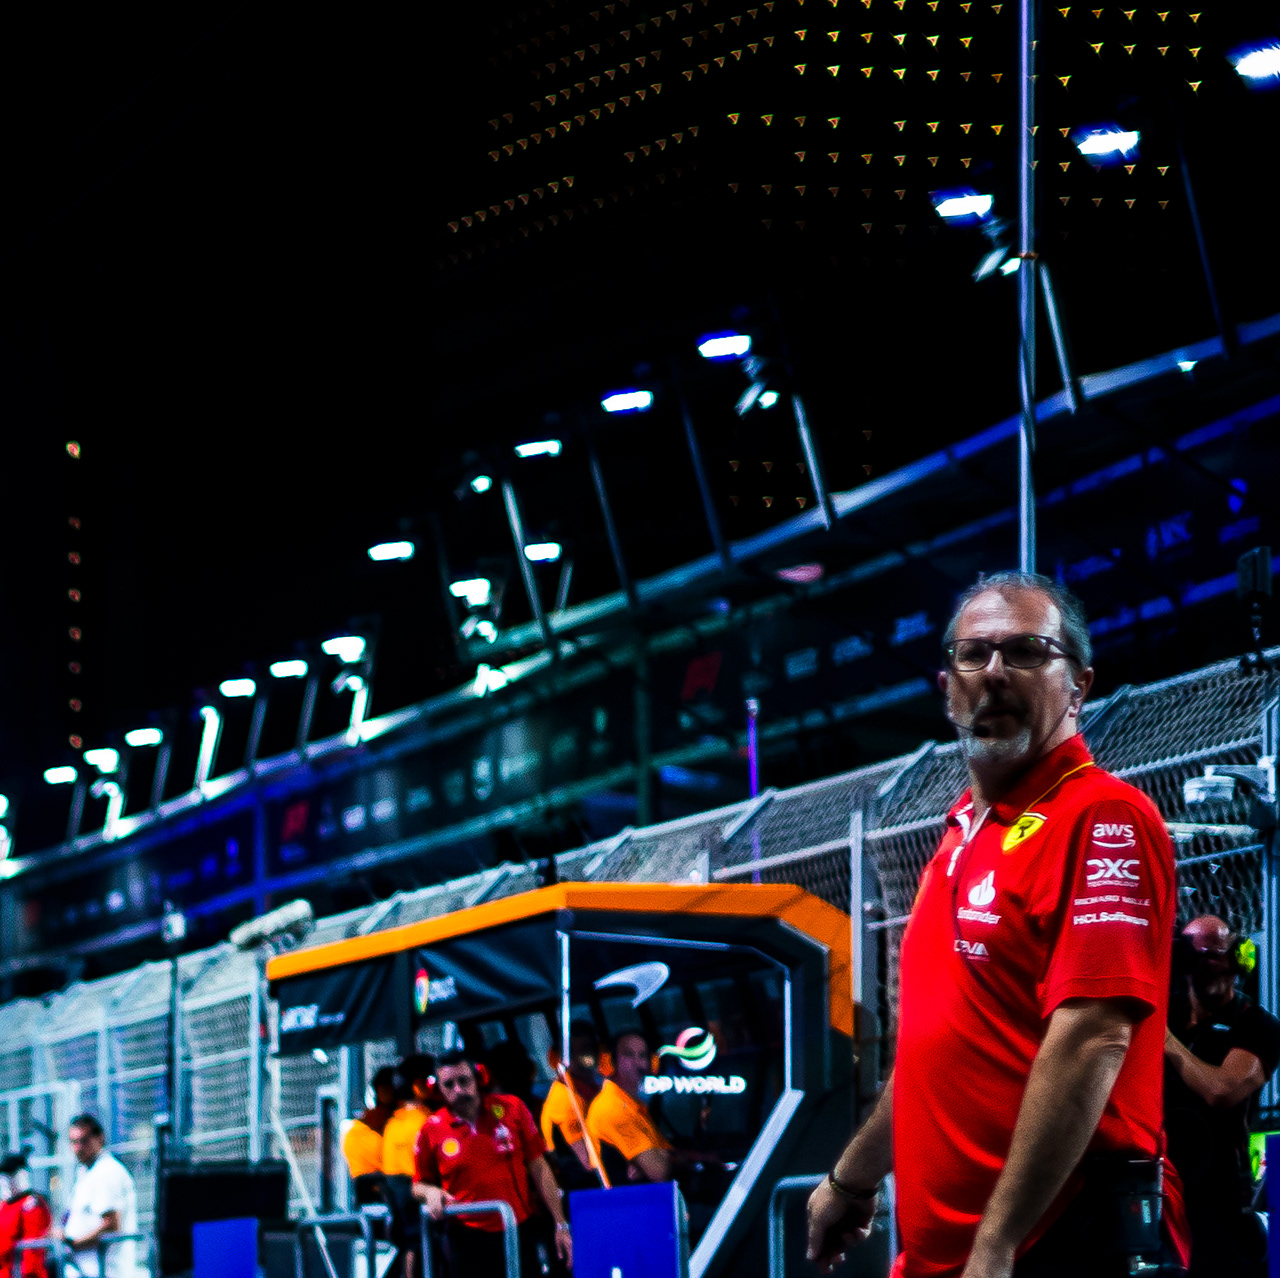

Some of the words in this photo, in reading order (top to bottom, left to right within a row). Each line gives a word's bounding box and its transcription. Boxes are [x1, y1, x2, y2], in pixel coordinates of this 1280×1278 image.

[1092, 823, 1135, 838] aws
[643, 1075, 673, 1095] DP
[673, 1075, 747, 1094] WORLD
